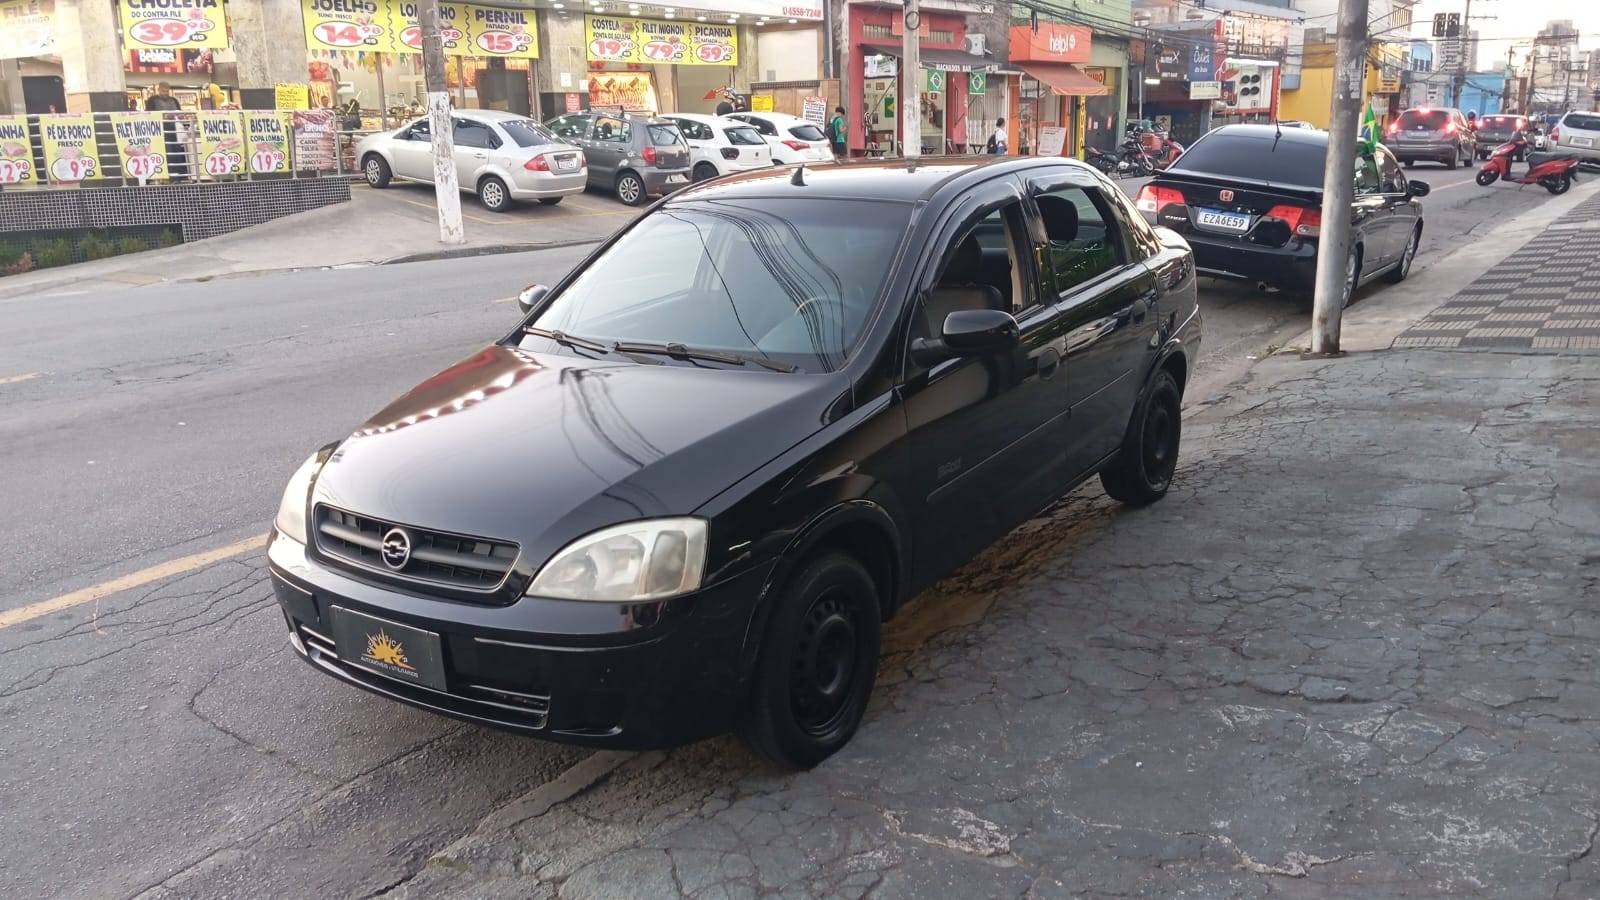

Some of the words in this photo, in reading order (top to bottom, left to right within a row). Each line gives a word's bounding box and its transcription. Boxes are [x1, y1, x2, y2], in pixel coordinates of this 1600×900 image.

[311, 0, 378, 14] JOELHO
[475, 9, 529, 25] PERNIL
[591, 18, 620, 31] COSTELA
[139, 22, 188, 41] 39
[320, 25, 362, 43] 14
[658, 24, 685, 36] MIGNON
[695, 26, 732, 38] PICANHA
[483, 34, 513, 50] 15
[596, 40, 621, 55] 19
[648, 44, 673, 58] 79
[701, 46, 721, 60] 59
[203, 119, 238, 134] PANCETA
[250, 118, 282, 133] BISTECA
[1203, 213, 1245, 229] EZA6E59
